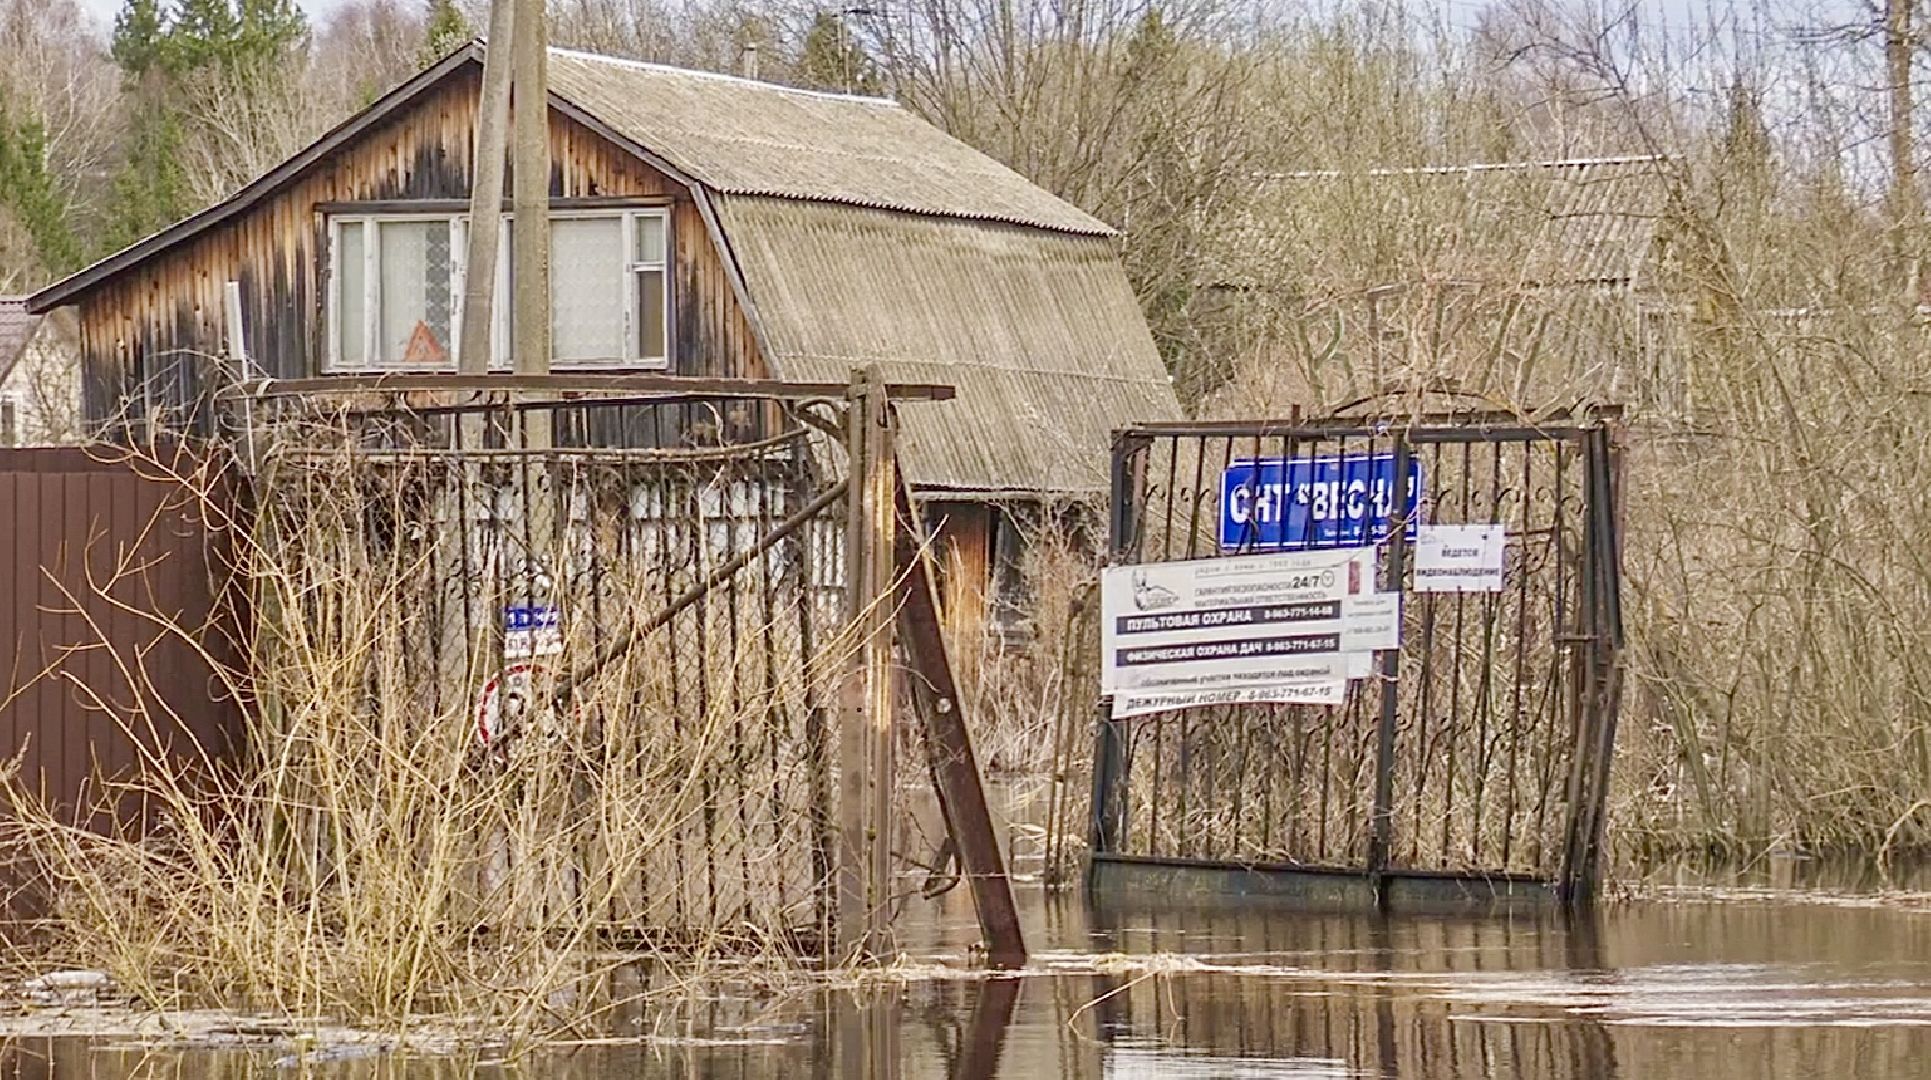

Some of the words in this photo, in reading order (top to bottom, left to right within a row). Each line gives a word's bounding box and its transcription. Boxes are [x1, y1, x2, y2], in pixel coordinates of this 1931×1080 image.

[1230, 483, 1290, 523] СНТ
[1127, 614, 1200, 631] ПУЛЬТОВАЯ
[1202, 609, 1252, 625] ОХРАНА
[1127, 647, 1195, 662] ФИЗИЧЕСКАЯ
[1197, 644, 1238, 656] ОХРАНА
[1240, 641, 1262, 655] ДАЧ
[1127, 694, 1195, 709] ДЕЖУРНЫЙ
[1199, 690, 1241, 703] НОМЕР
